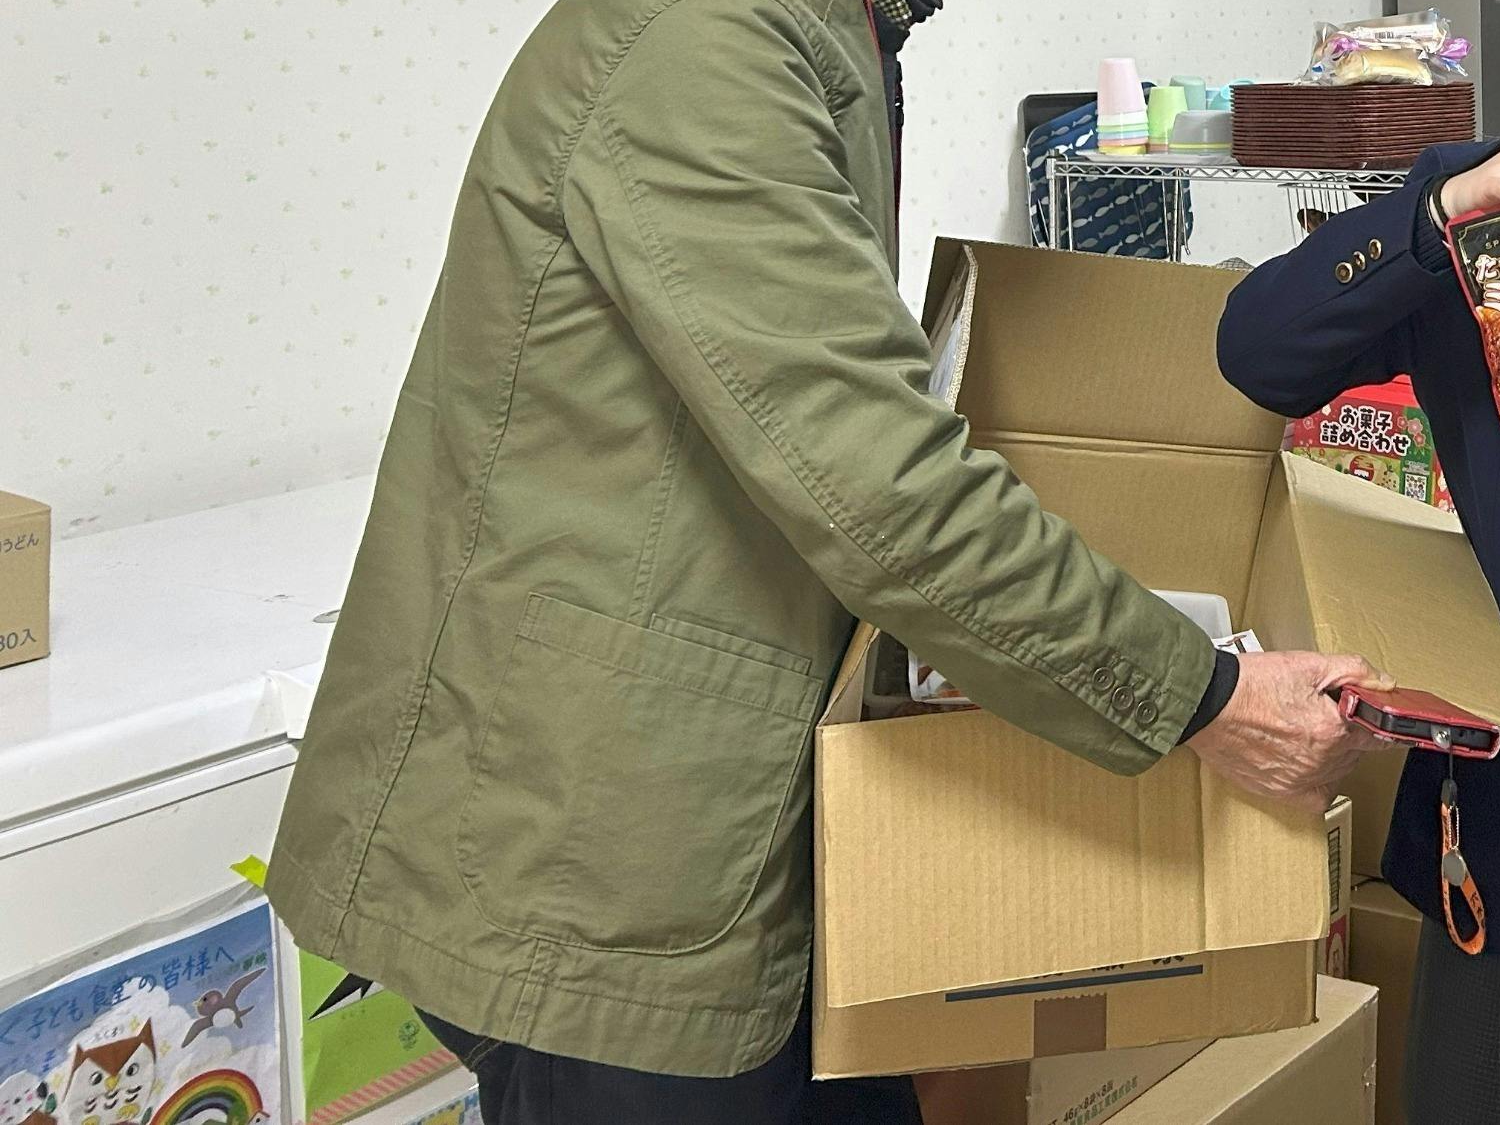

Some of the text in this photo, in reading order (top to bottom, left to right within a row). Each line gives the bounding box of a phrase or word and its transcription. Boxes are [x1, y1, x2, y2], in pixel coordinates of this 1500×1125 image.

[1341, 407, 1392, 432] お菓子
[1321, 421, 1411, 456] 詰め合わせ
[0, 532, 39, 553] うどん
